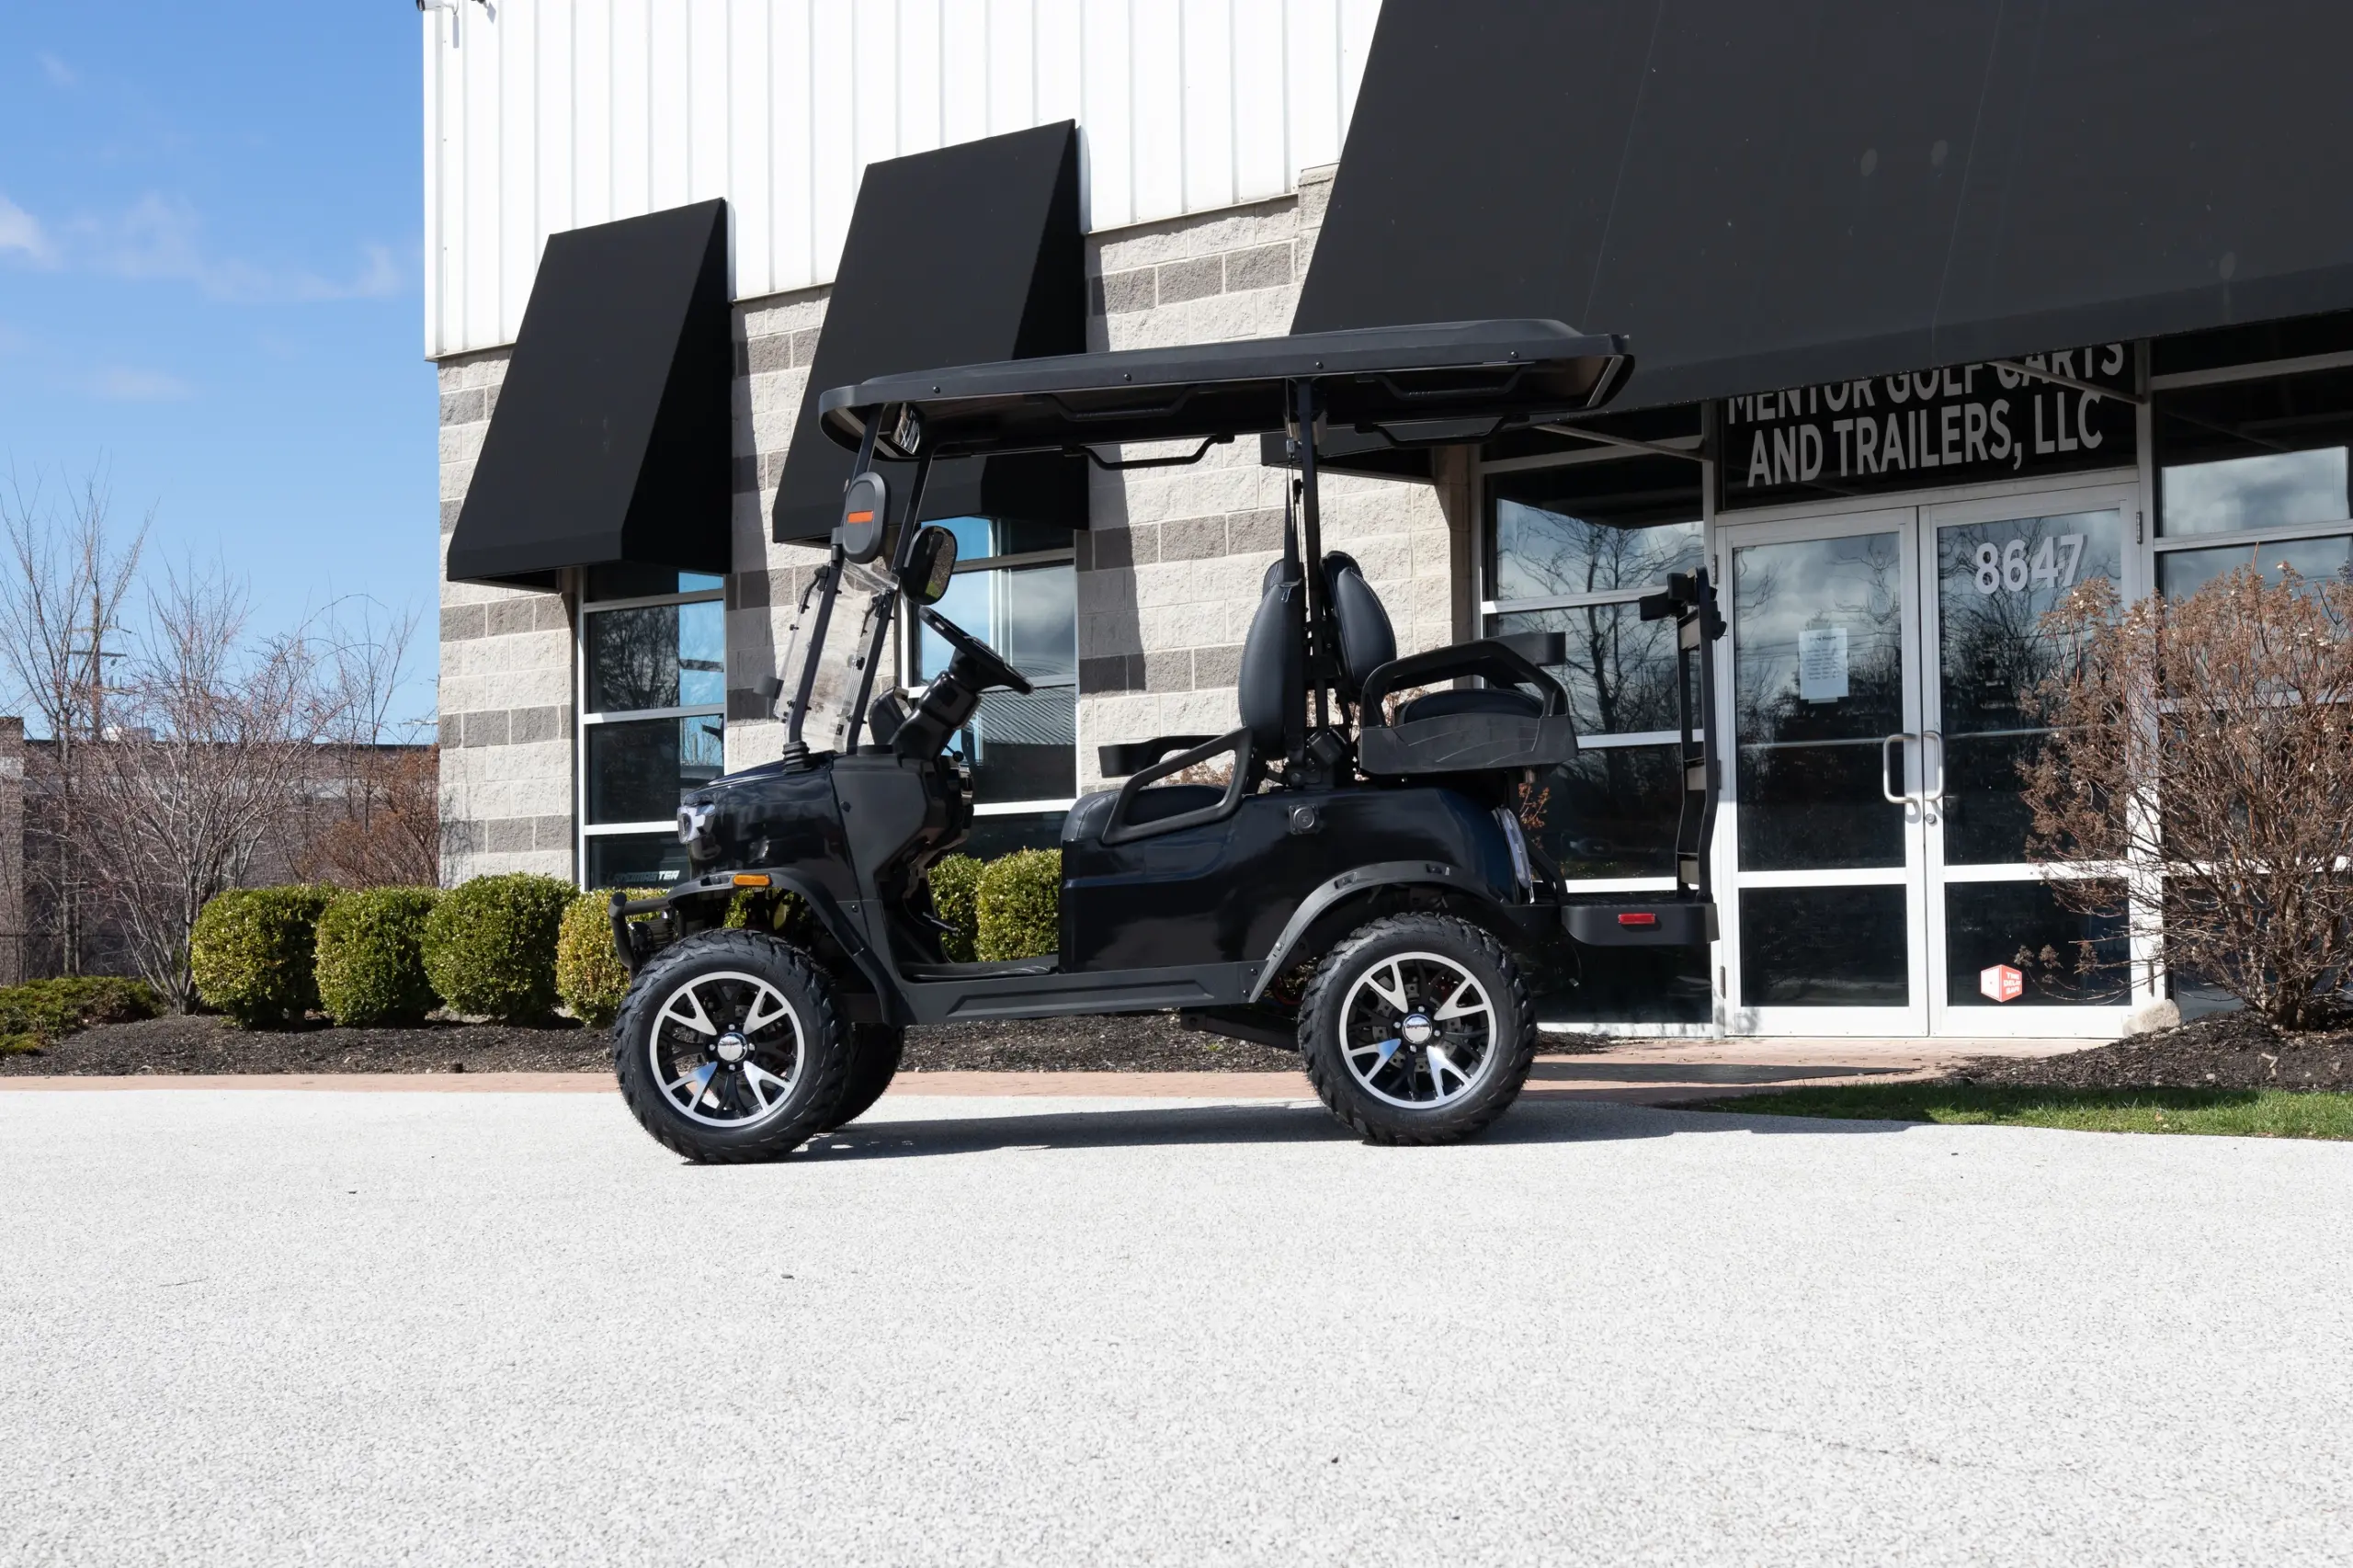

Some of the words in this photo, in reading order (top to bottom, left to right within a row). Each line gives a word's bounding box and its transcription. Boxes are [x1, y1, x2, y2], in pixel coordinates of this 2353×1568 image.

[1747, 424, 1824, 488] AND
[1833, 399, 2022, 477] TRAILERS,
[2034, 390, 2103, 455] LLC
[1975, 533, 2084, 595] 8647
